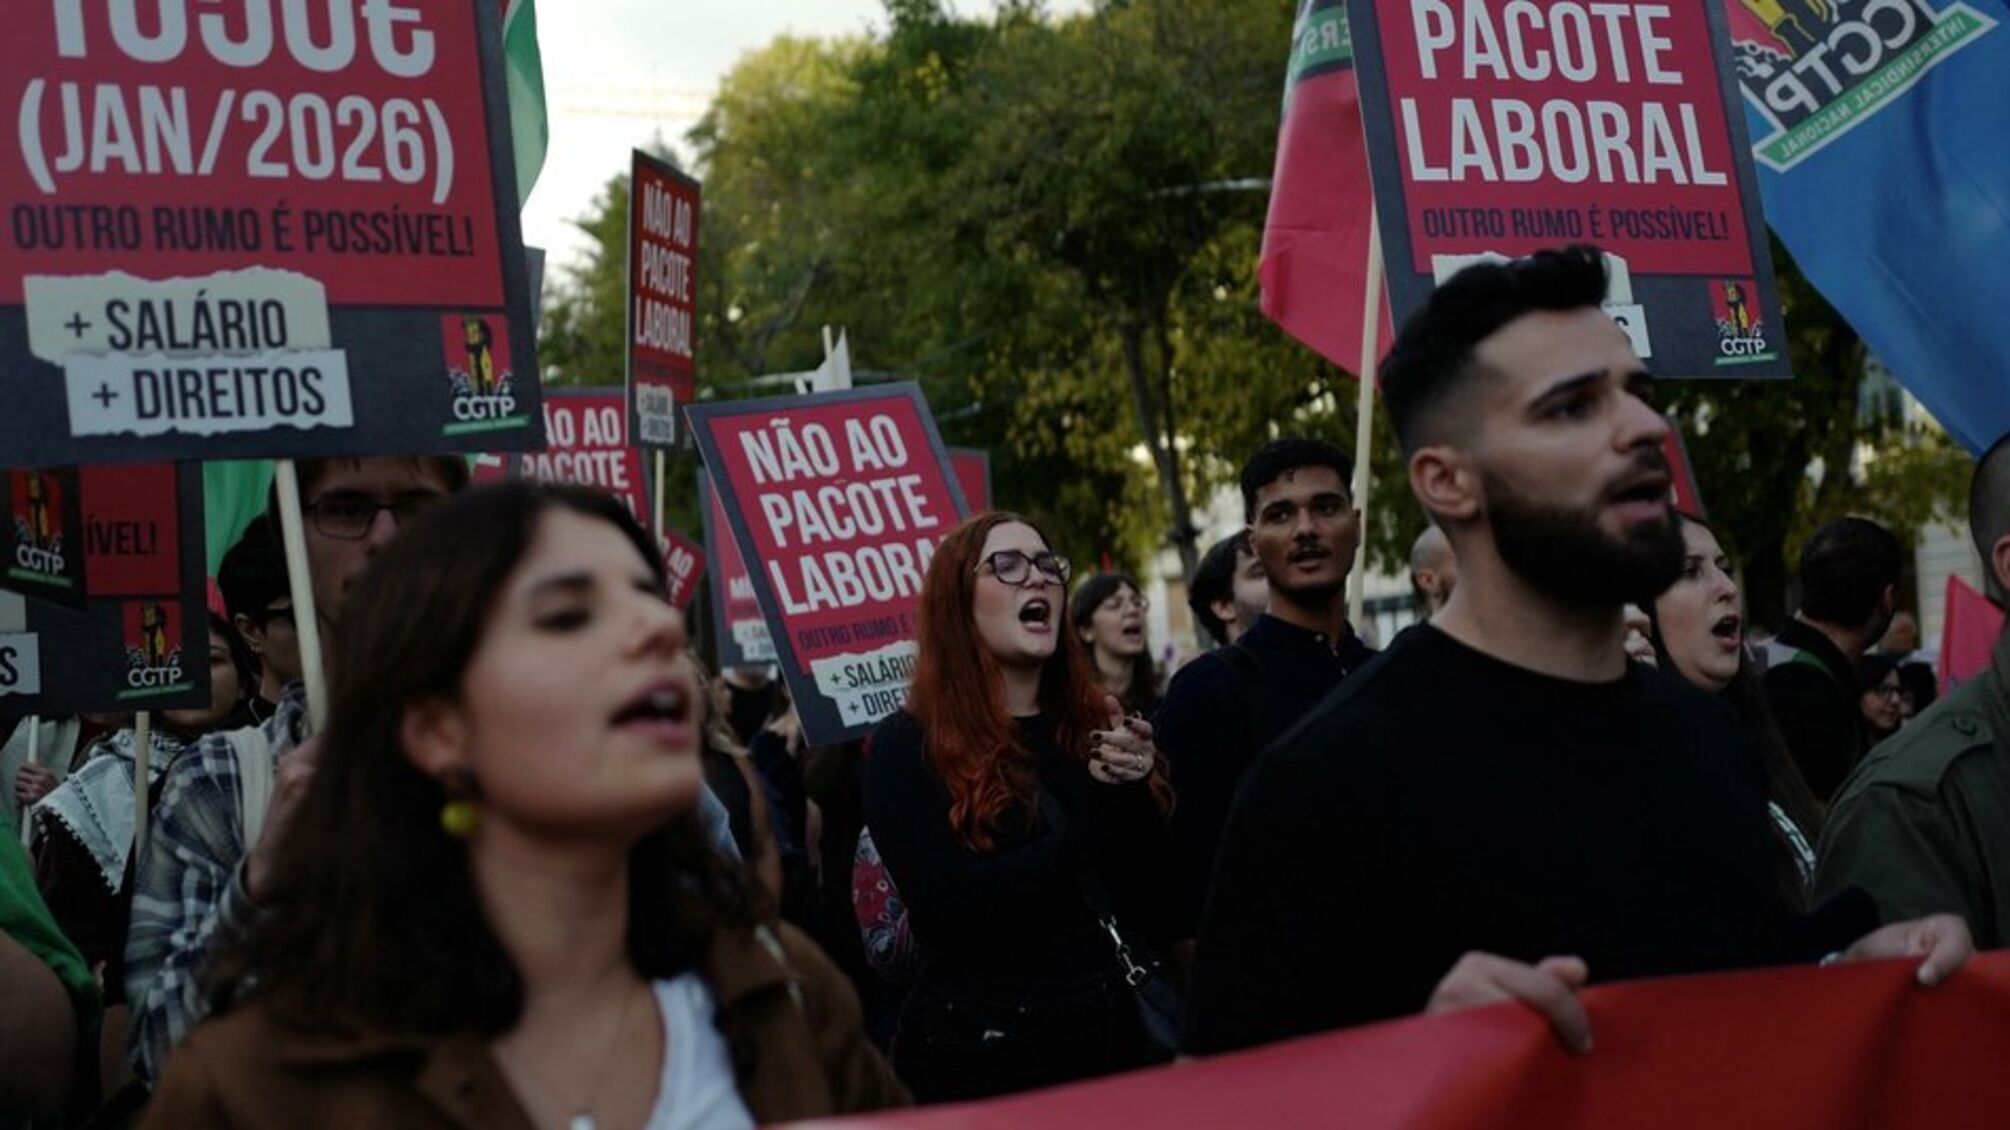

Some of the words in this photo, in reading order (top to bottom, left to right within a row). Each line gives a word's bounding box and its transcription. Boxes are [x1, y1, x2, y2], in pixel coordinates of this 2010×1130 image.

[1411, 0, 1684, 84] PACOTE
[18, 78, 455, 204] (JAN/2026)
[1401, 98, 1728, 186] LABORAL
[12, 203, 141, 251] OUTRO
[155, 206, 262, 252] RUMO
[273, 200, 294, 253] É
[304, 203, 475, 257] POSSÍVEL!
[643, 179, 671, 239] NÃO
[673, 196, 692, 248] AO
[1423, 208, 1505, 239] OUTRO
[1512, 209, 1582, 239] RUMO
[1589, 203, 1604, 240] É
[1611, 204, 1729, 241] POSSÍVEL!
[641, 239, 690, 302] PACOTE
[64, 312, 91, 338] +
[106, 289, 288, 351] SALÁRIO
[636, 294, 693, 358] LABORAL
[1721, 338, 1766, 355] CGTP
[92, 383, 118, 408] +
[133, 366, 326, 420] DIREITOS
[453, 395, 516, 420] CGTP
[583, 407, 621, 447] AO
[738, 417, 840, 484] NÃO
[845, 414, 908, 472] AO
[87, 514, 157, 556] ÍVEL!
[759, 474, 939, 548] PACOTE
[16, 543, 65, 575] CGTP
[768, 535, 946, 615] LABORA
[797, 624, 851, 651] OUTRO
[852, 616, 898, 643] RUMO
[127, 666, 184, 688] CGTP
[862, 685, 911, 716] DIRE
